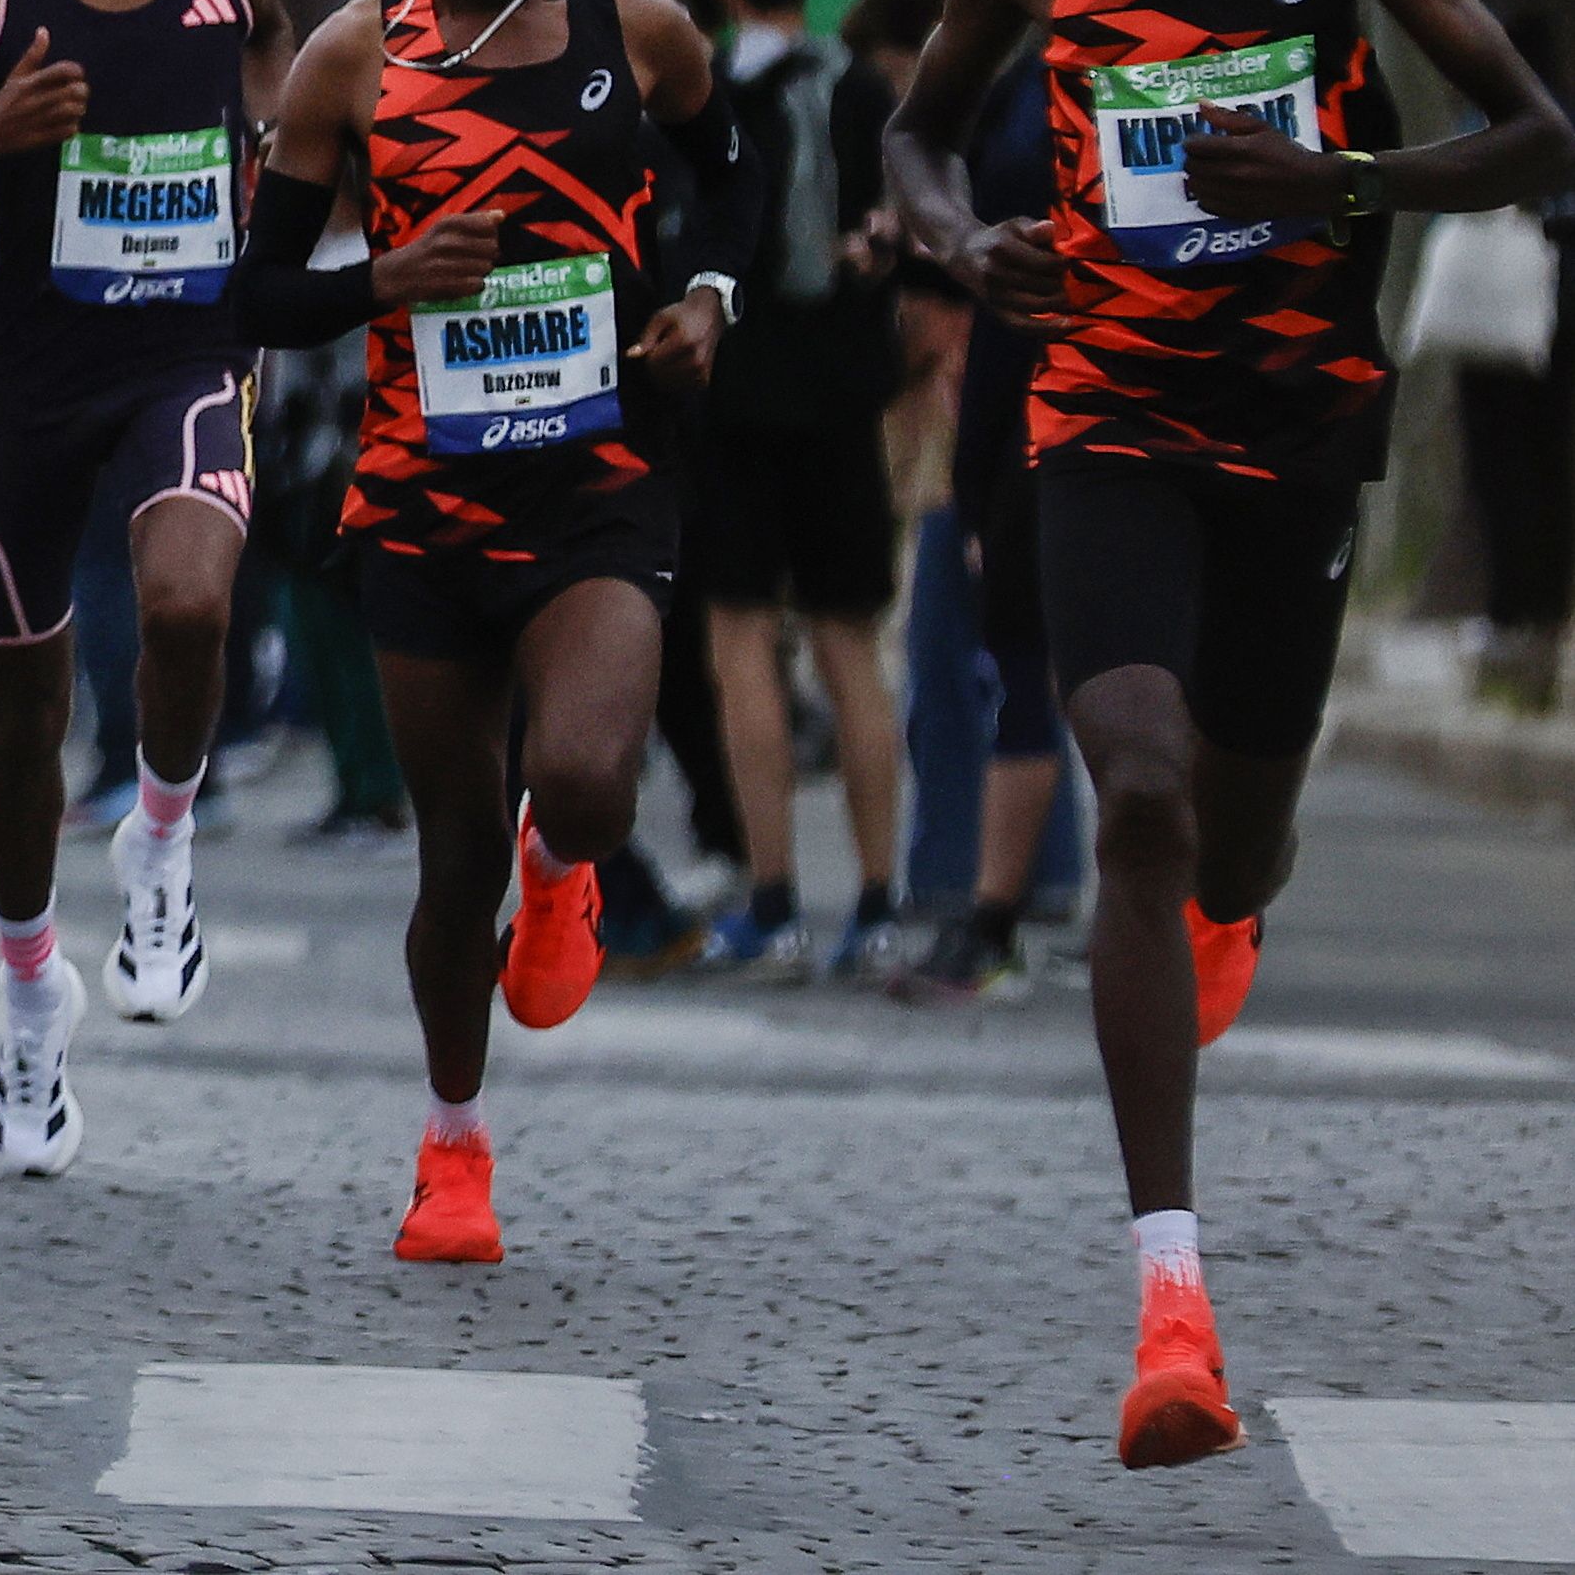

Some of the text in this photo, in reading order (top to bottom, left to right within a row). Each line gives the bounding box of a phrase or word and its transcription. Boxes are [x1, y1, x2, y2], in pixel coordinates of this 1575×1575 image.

[1130, 51, 1271, 91] Schneider
[79, 175, 220, 221] MEGERSA
[445, 304, 587, 363] ASMARE
